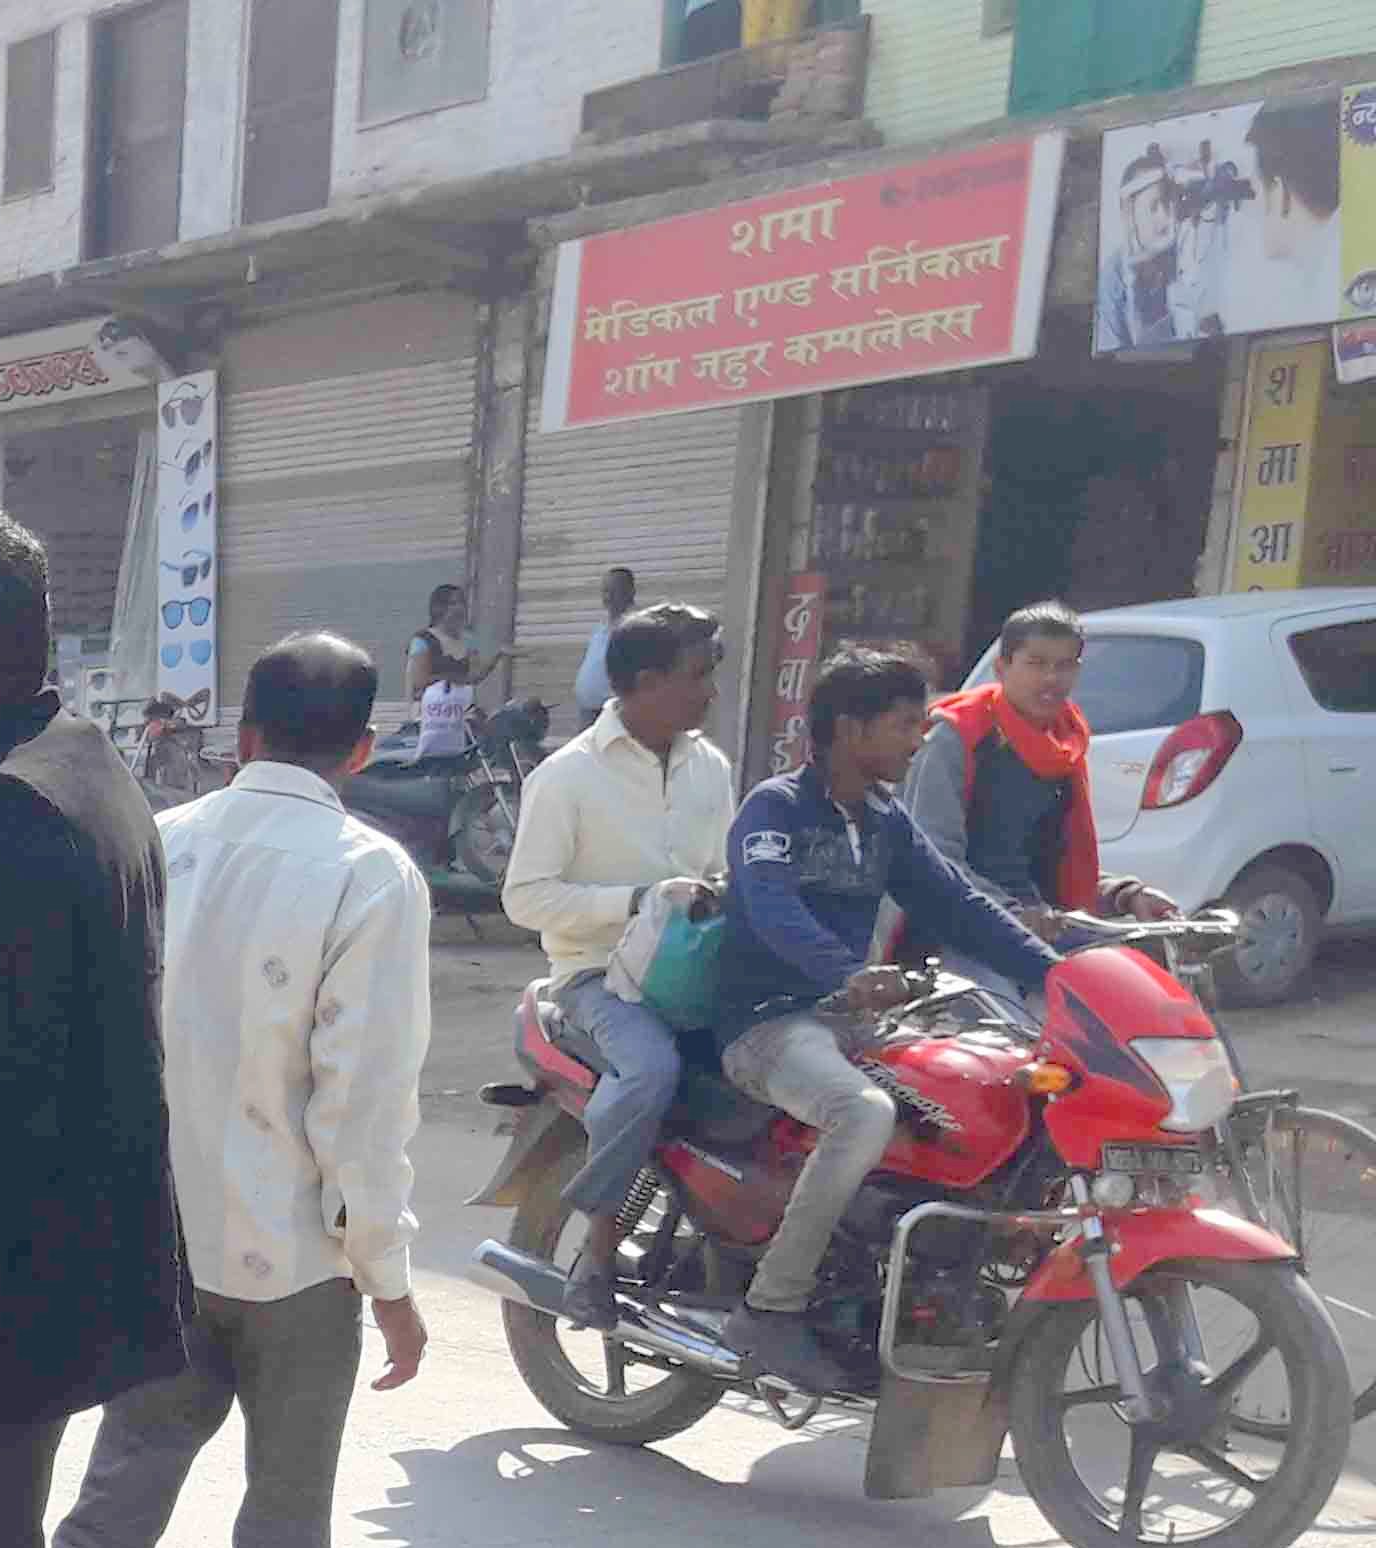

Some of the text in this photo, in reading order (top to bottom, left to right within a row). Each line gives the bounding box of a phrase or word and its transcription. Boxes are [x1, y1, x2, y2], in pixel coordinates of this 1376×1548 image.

[730, 198, 845, 257] शमा
[585, 235, 1010, 344] मेडिकल एण्ड सर्जिकल
[604, 353, 681, 395] शॉप
[692, 340, 775, 388] जहुर
